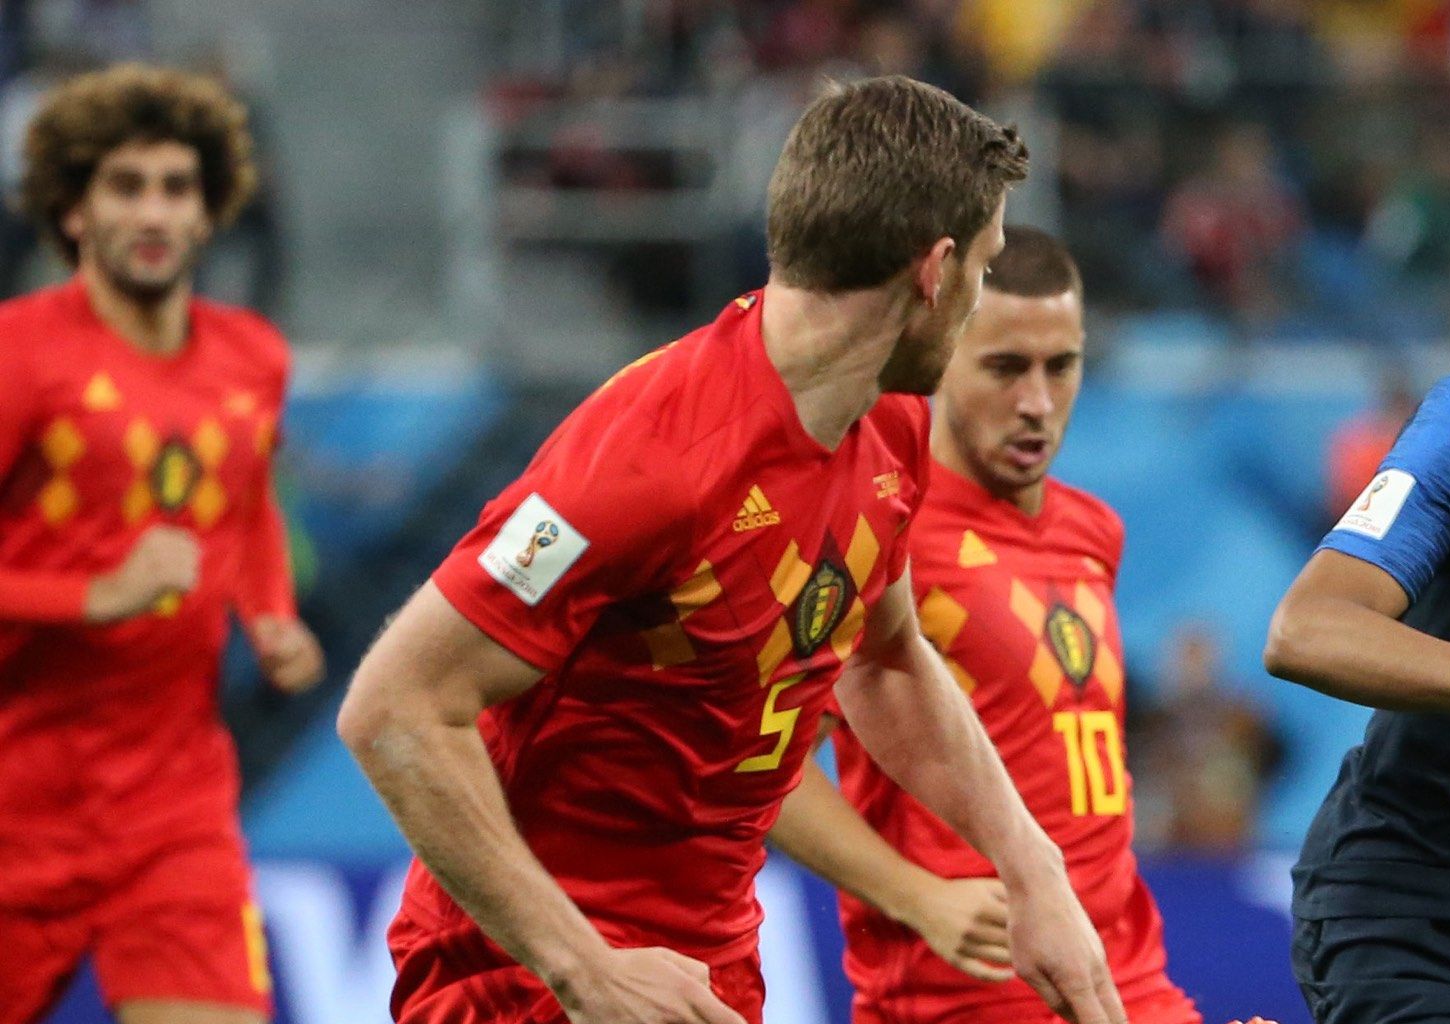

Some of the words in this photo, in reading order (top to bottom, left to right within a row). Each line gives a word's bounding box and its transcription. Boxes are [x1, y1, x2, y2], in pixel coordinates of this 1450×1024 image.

[733, 511, 780, 532] adidas
[734, 671, 808, 774] 5
[1052, 711, 1125, 817] 10
